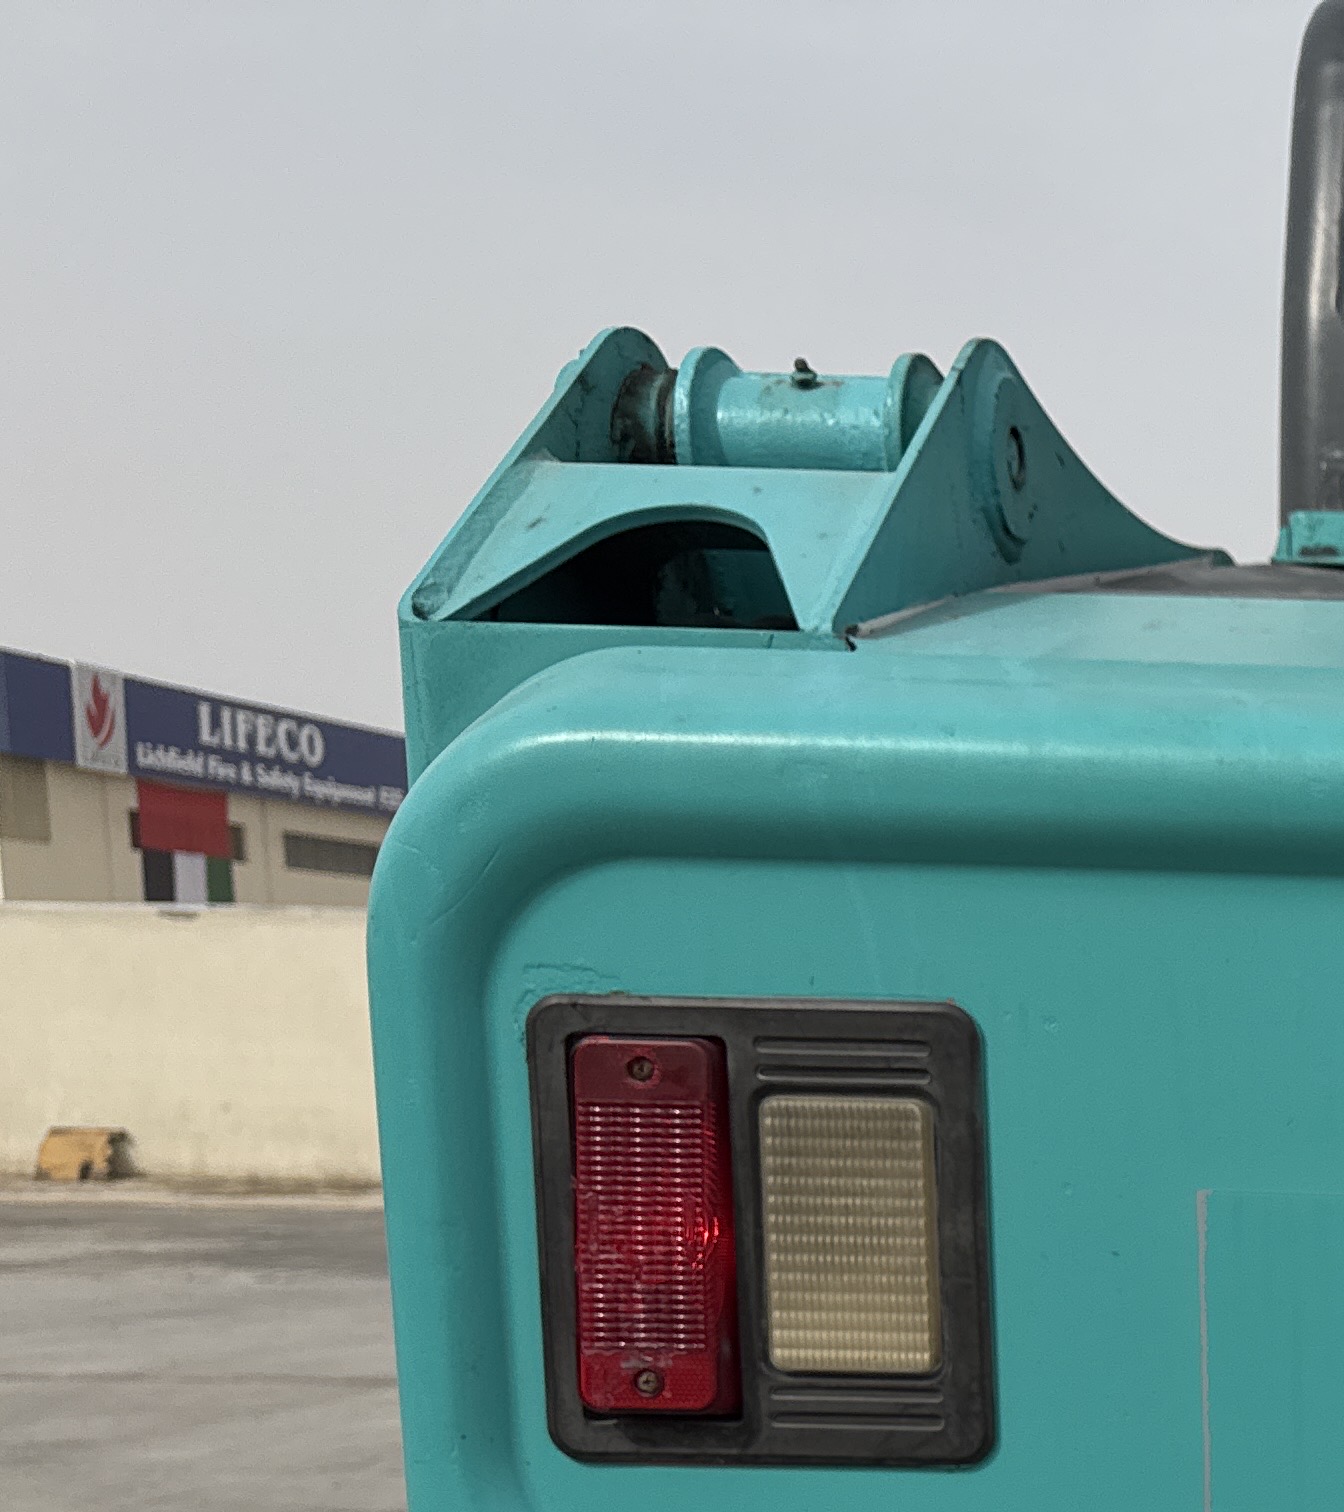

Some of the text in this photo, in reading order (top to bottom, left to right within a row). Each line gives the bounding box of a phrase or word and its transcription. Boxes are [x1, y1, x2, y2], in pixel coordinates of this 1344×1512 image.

[198, 702, 326, 768] LIFECO
[241, 760, 254, 787] &
[255, 763, 299, 801] Safety
